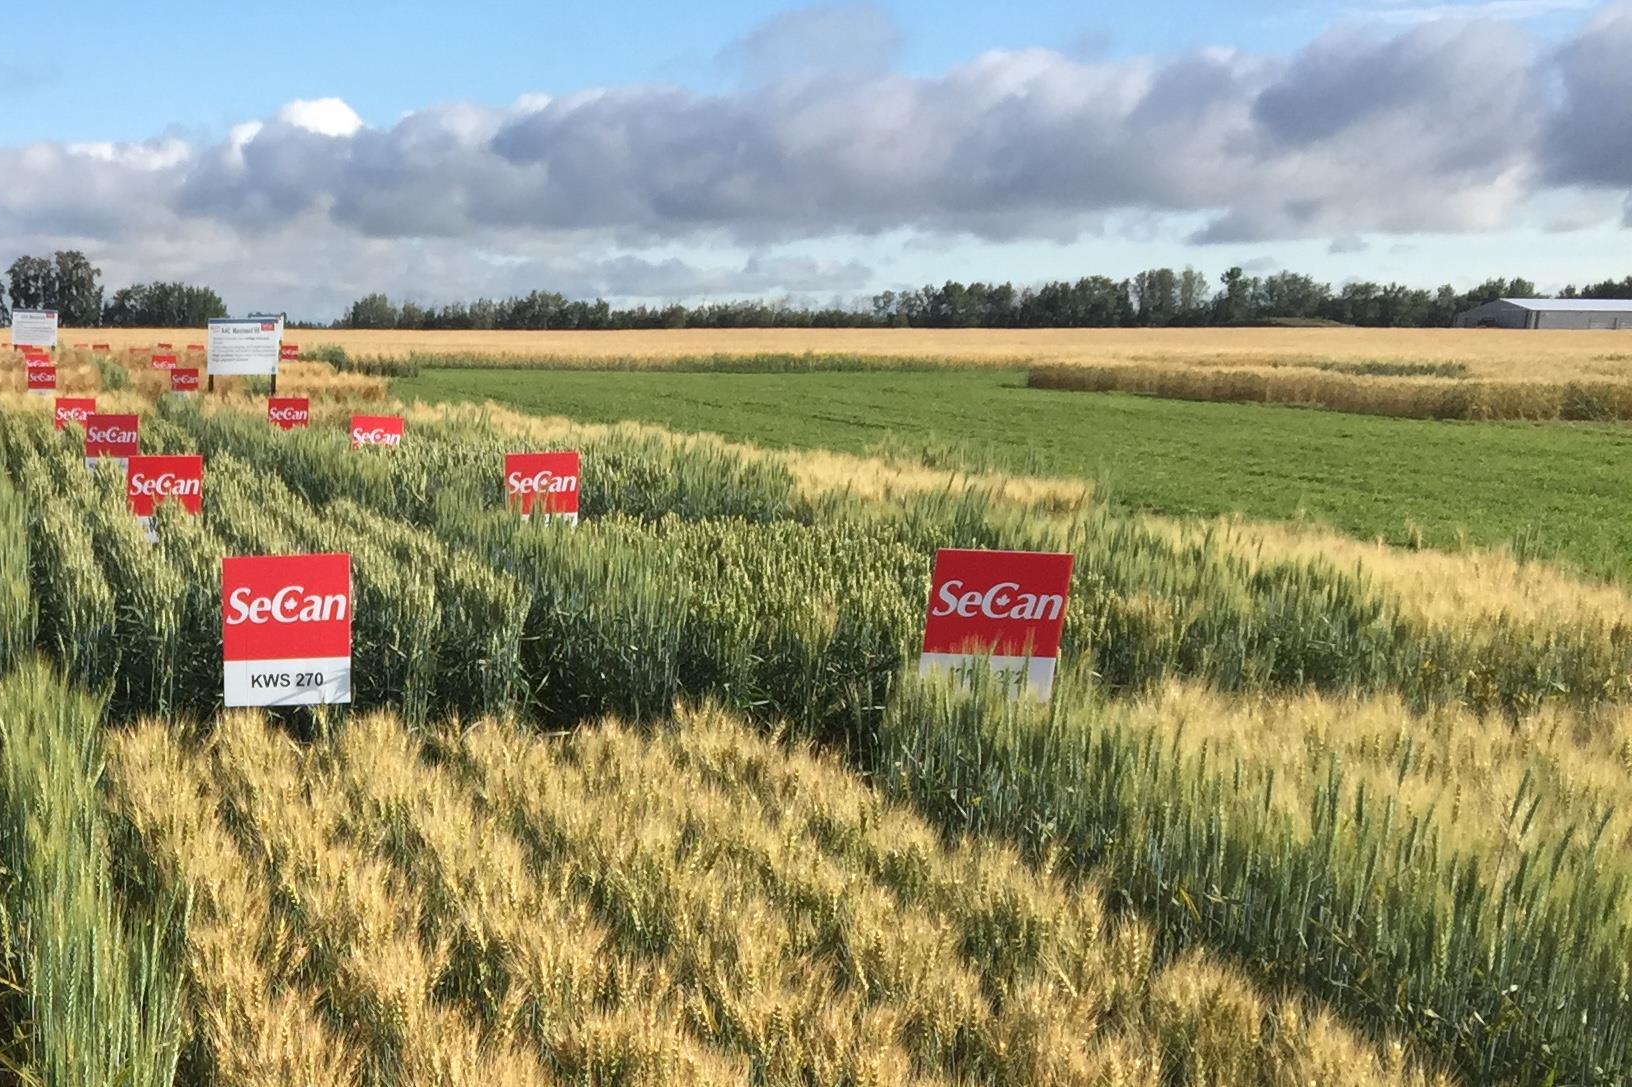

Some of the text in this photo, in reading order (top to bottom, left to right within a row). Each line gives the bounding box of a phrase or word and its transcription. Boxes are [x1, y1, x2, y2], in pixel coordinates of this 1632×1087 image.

[56, 407, 95, 421] SeCa
[270, 407, 308, 420] SeCan
[86, 426, 136, 444] SeCan
[352, 427, 401, 445] SeCan
[130, 473, 200, 496] SeCan
[508, 470, 577, 494] SeCan
[226, 585, 347, 625] SeCan
[932, 580, 1064, 620] SeCan
[251, 672, 324, 688] KWS 270
